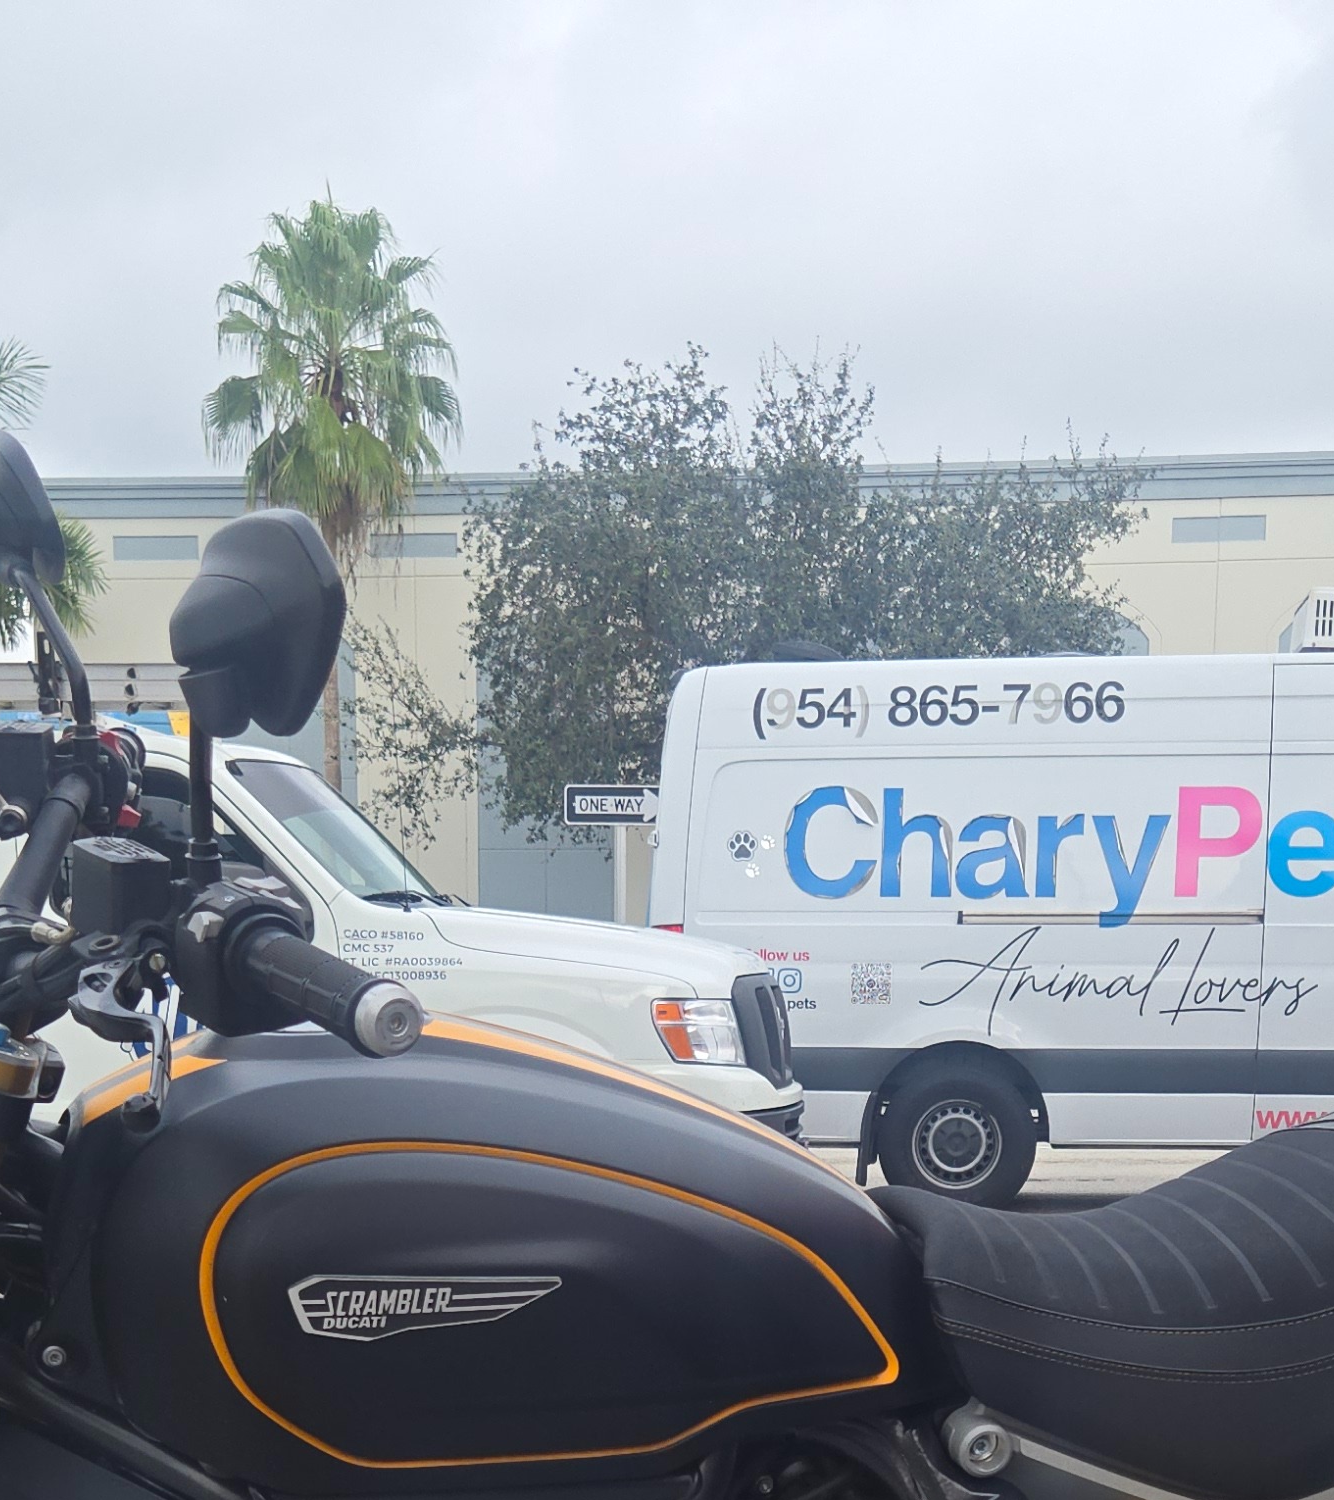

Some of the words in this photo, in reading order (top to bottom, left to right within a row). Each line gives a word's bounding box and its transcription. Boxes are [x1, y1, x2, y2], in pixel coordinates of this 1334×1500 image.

[752, 684, 870, 741] (954)
[887, 680, 1126, 728] 865-7966
[579, 797, 609, 812] ONE
[613, 797, 645, 812] WAY
[343, 929, 378, 940] CACO
[381, 931, 425, 941] #58160
[343, 943, 370, 953] CMC
[373, 944, 394, 953] 537
[362, 957, 379, 967] LIC
[793, 950, 810, 962] us
[919, 925, 1158, 1036] Animal
[1158, 926, 1319, 1026] Lovers
[325, 1287, 453, 1317] SCRAMBLER
[322, 1316, 387, 1330] DUCATI
